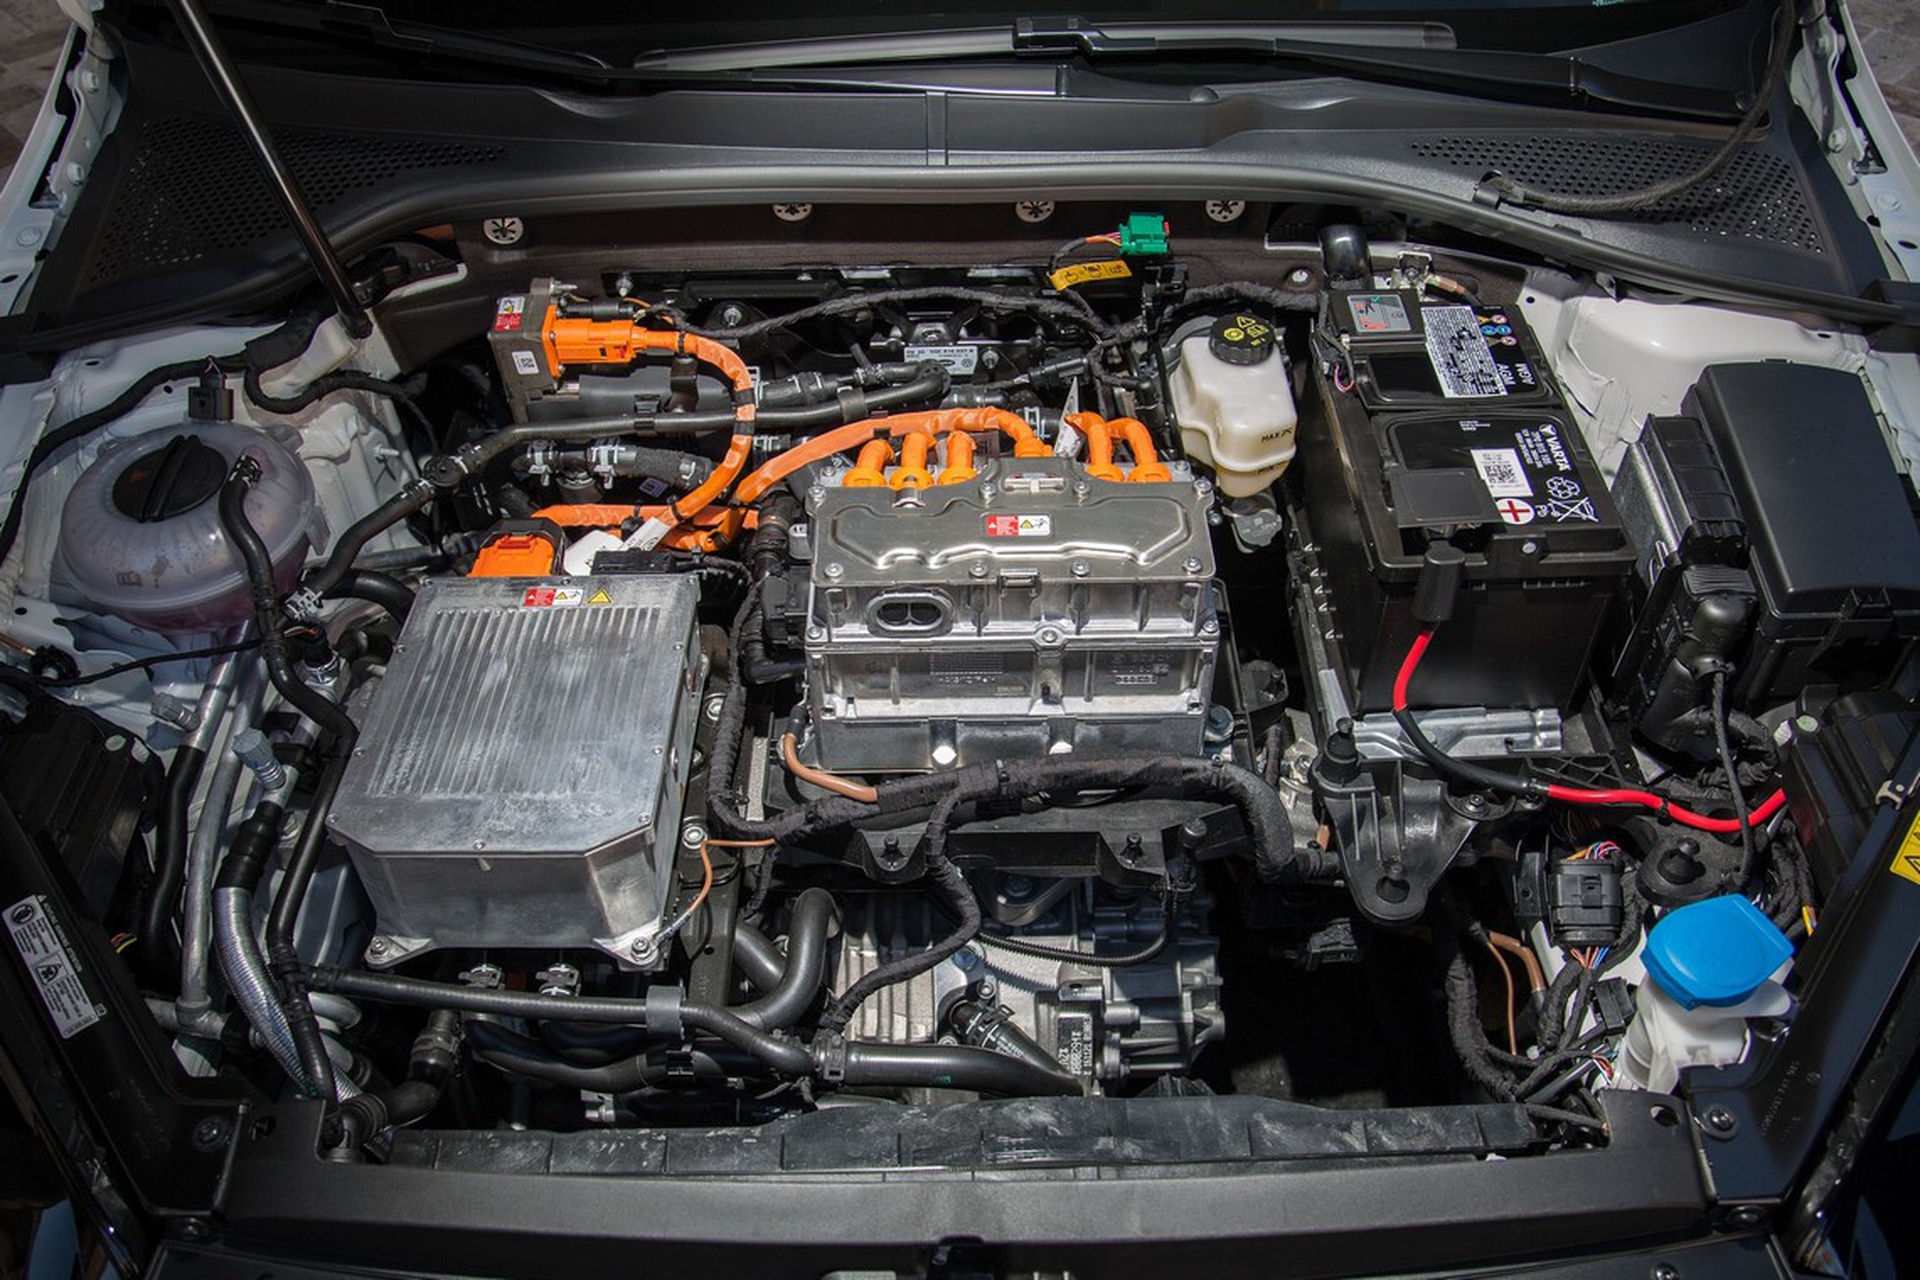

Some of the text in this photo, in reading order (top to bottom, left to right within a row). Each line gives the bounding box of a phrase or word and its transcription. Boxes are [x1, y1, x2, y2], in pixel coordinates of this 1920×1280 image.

[1497, 363, 1516, 385] AGM
[1515, 363, 1535, 385] AGM
[1261, 431, 1280, 443] MAX
[1546, 436, 1572, 471] VARTA
